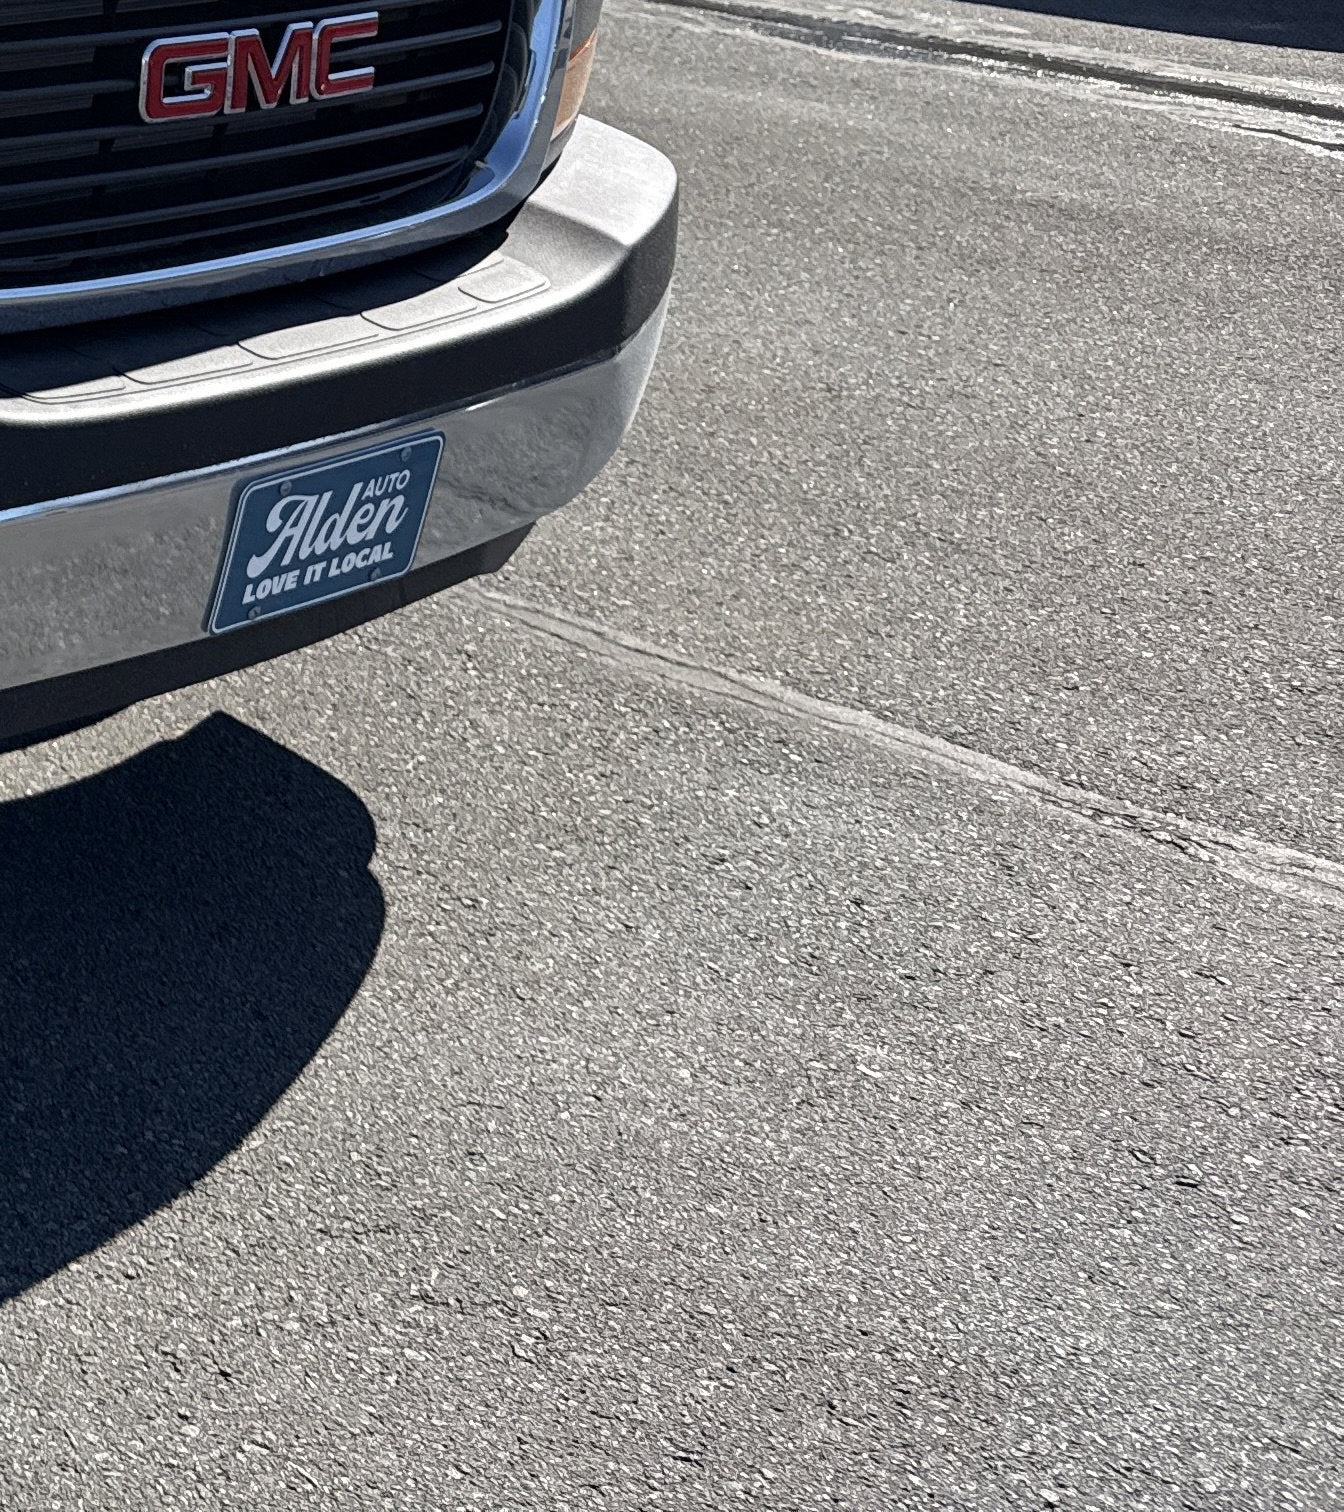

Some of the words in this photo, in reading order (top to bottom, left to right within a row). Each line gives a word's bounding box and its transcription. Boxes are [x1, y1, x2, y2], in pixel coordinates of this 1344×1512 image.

[138, 11, 379, 124] GMC
[361, 469, 411, 500] AUTO
[246, 481, 409, 579] Alden
[242, 569, 300, 605] LOVE
[304, 561, 327, 585] IT
[328, 541, 394, 578] LOCAL
